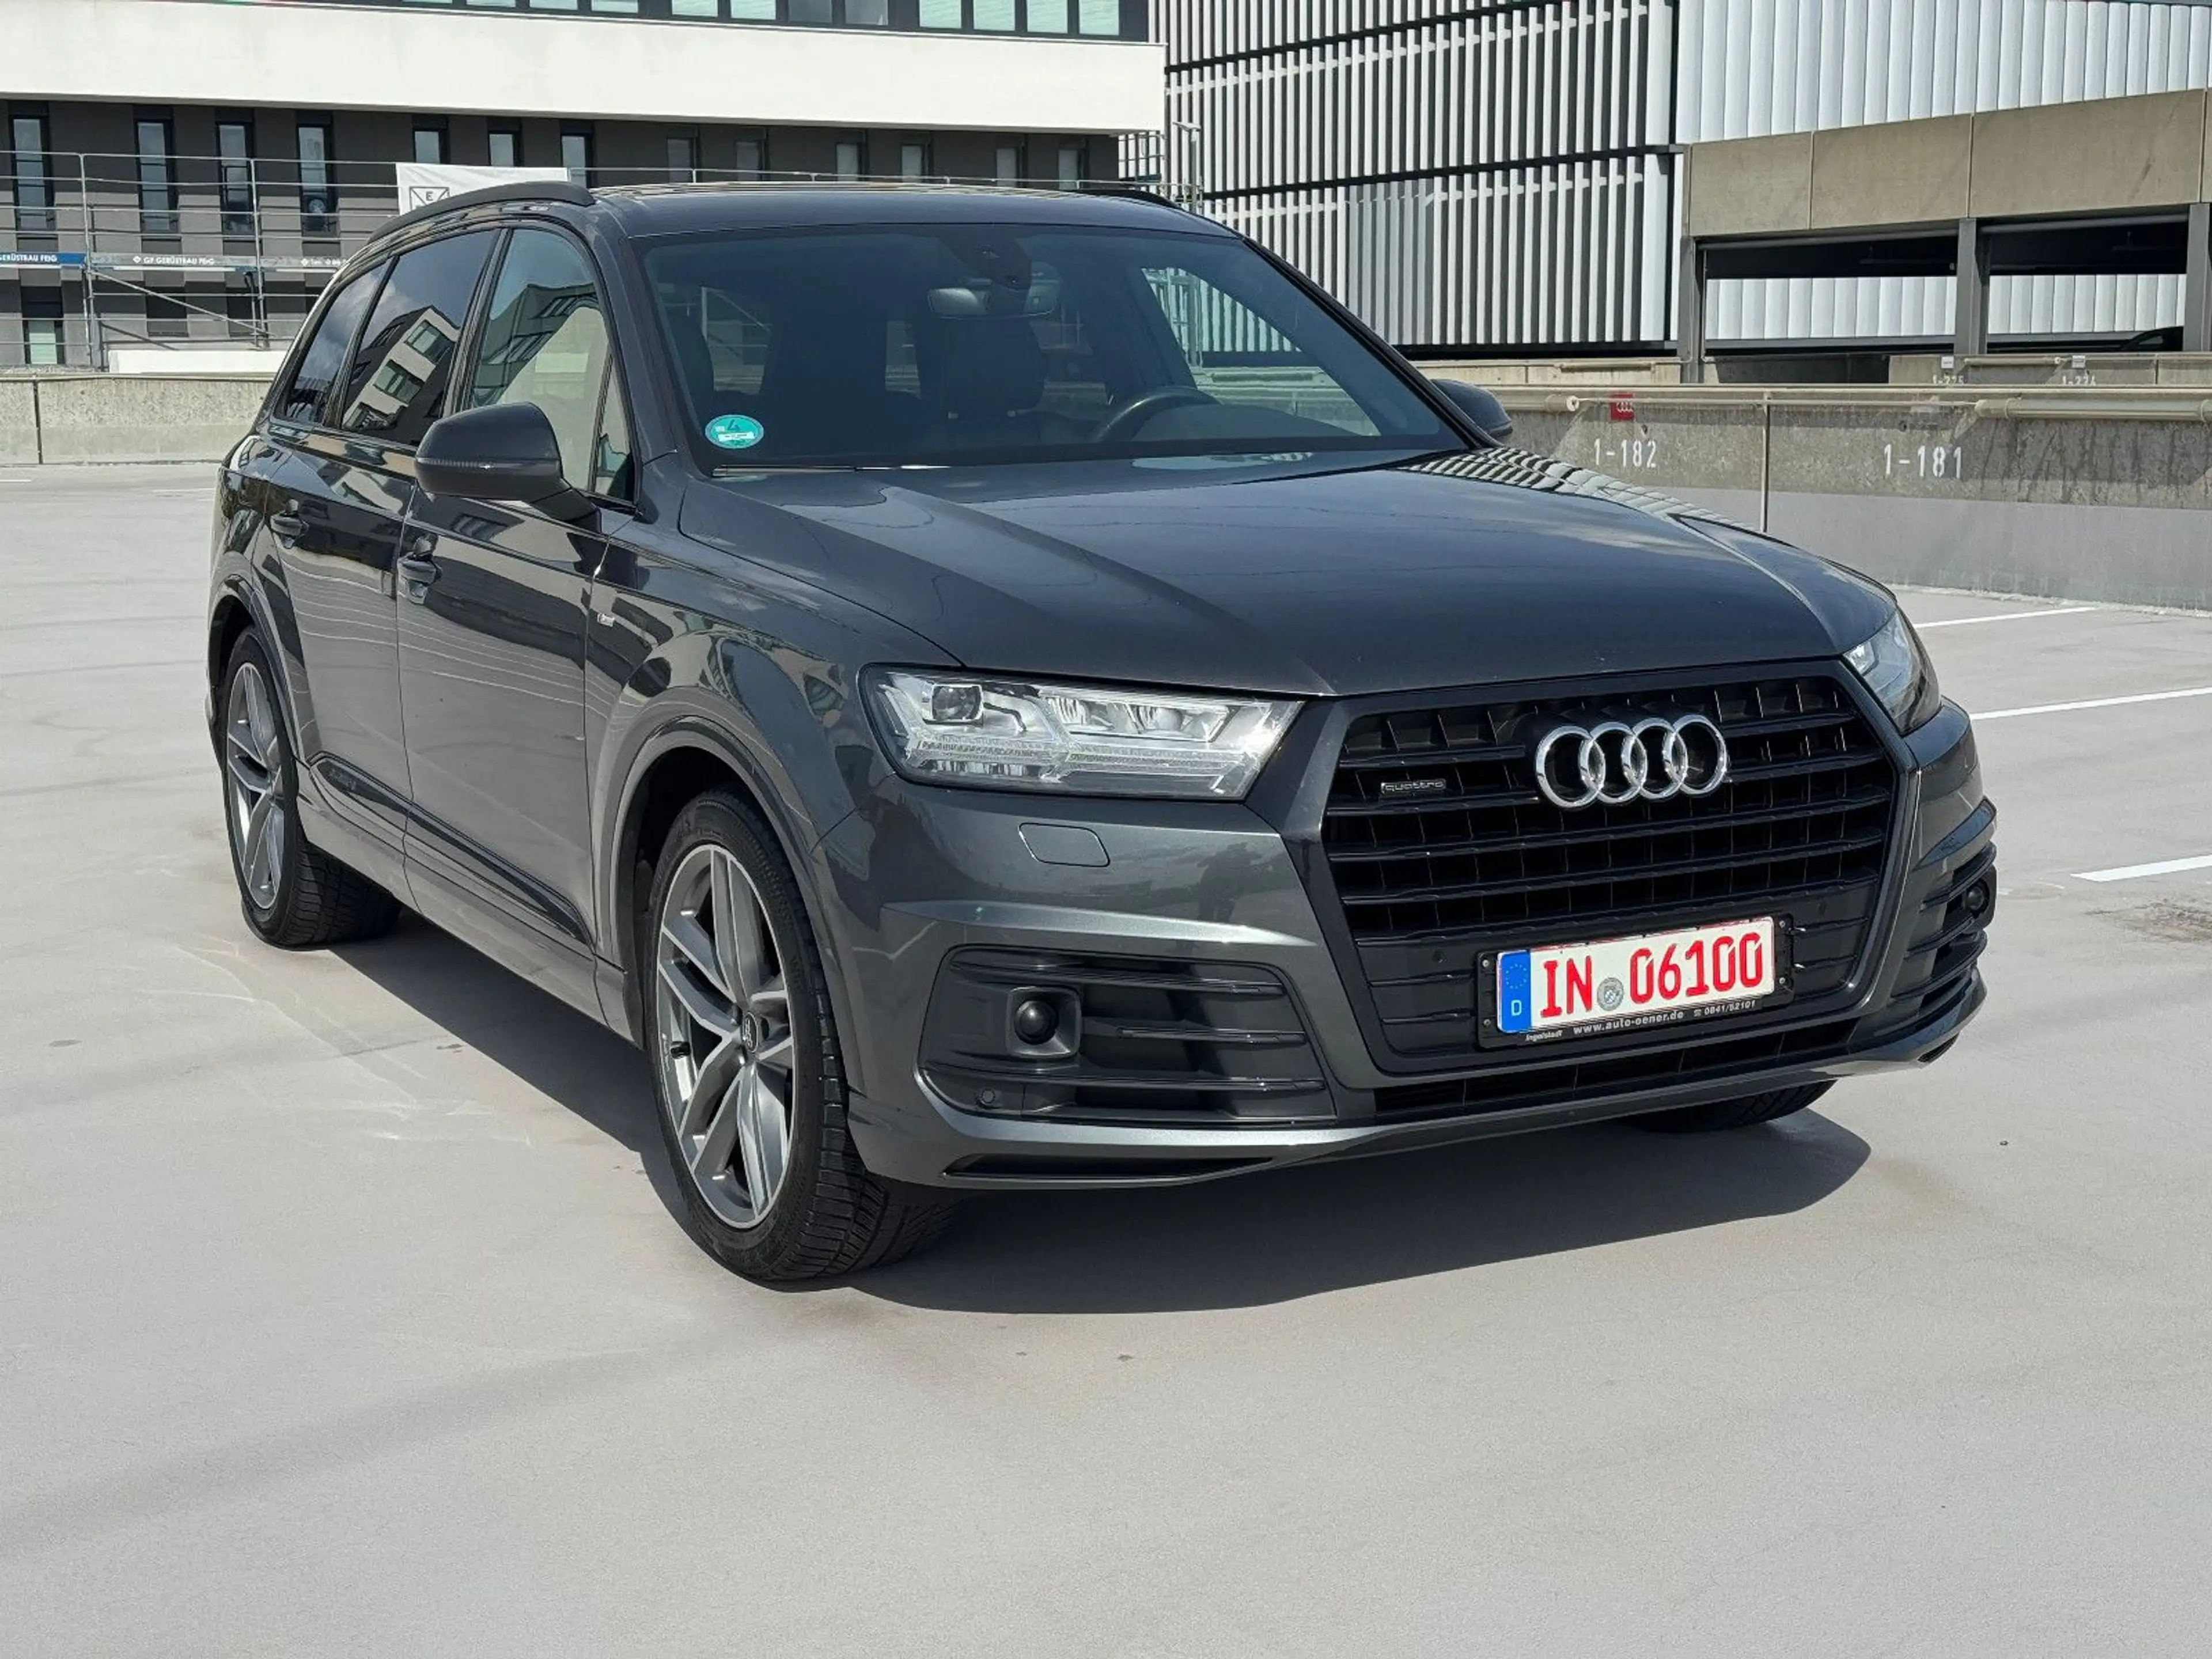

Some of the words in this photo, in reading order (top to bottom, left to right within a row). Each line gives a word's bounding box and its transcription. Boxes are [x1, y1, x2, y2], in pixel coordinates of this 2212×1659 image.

[426, 191, 433, 201] E
[1594, 438, 1657, 468] 1-182
[1884, 444, 1962, 479] 1-181
[1540, 955, 1593, 1018] IN
[1630, 931, 1763, 1005] 06100
[1511, 999, 1522, 1016] D
[1573, 1010, 1684, 1035] www.auto-oener.de
